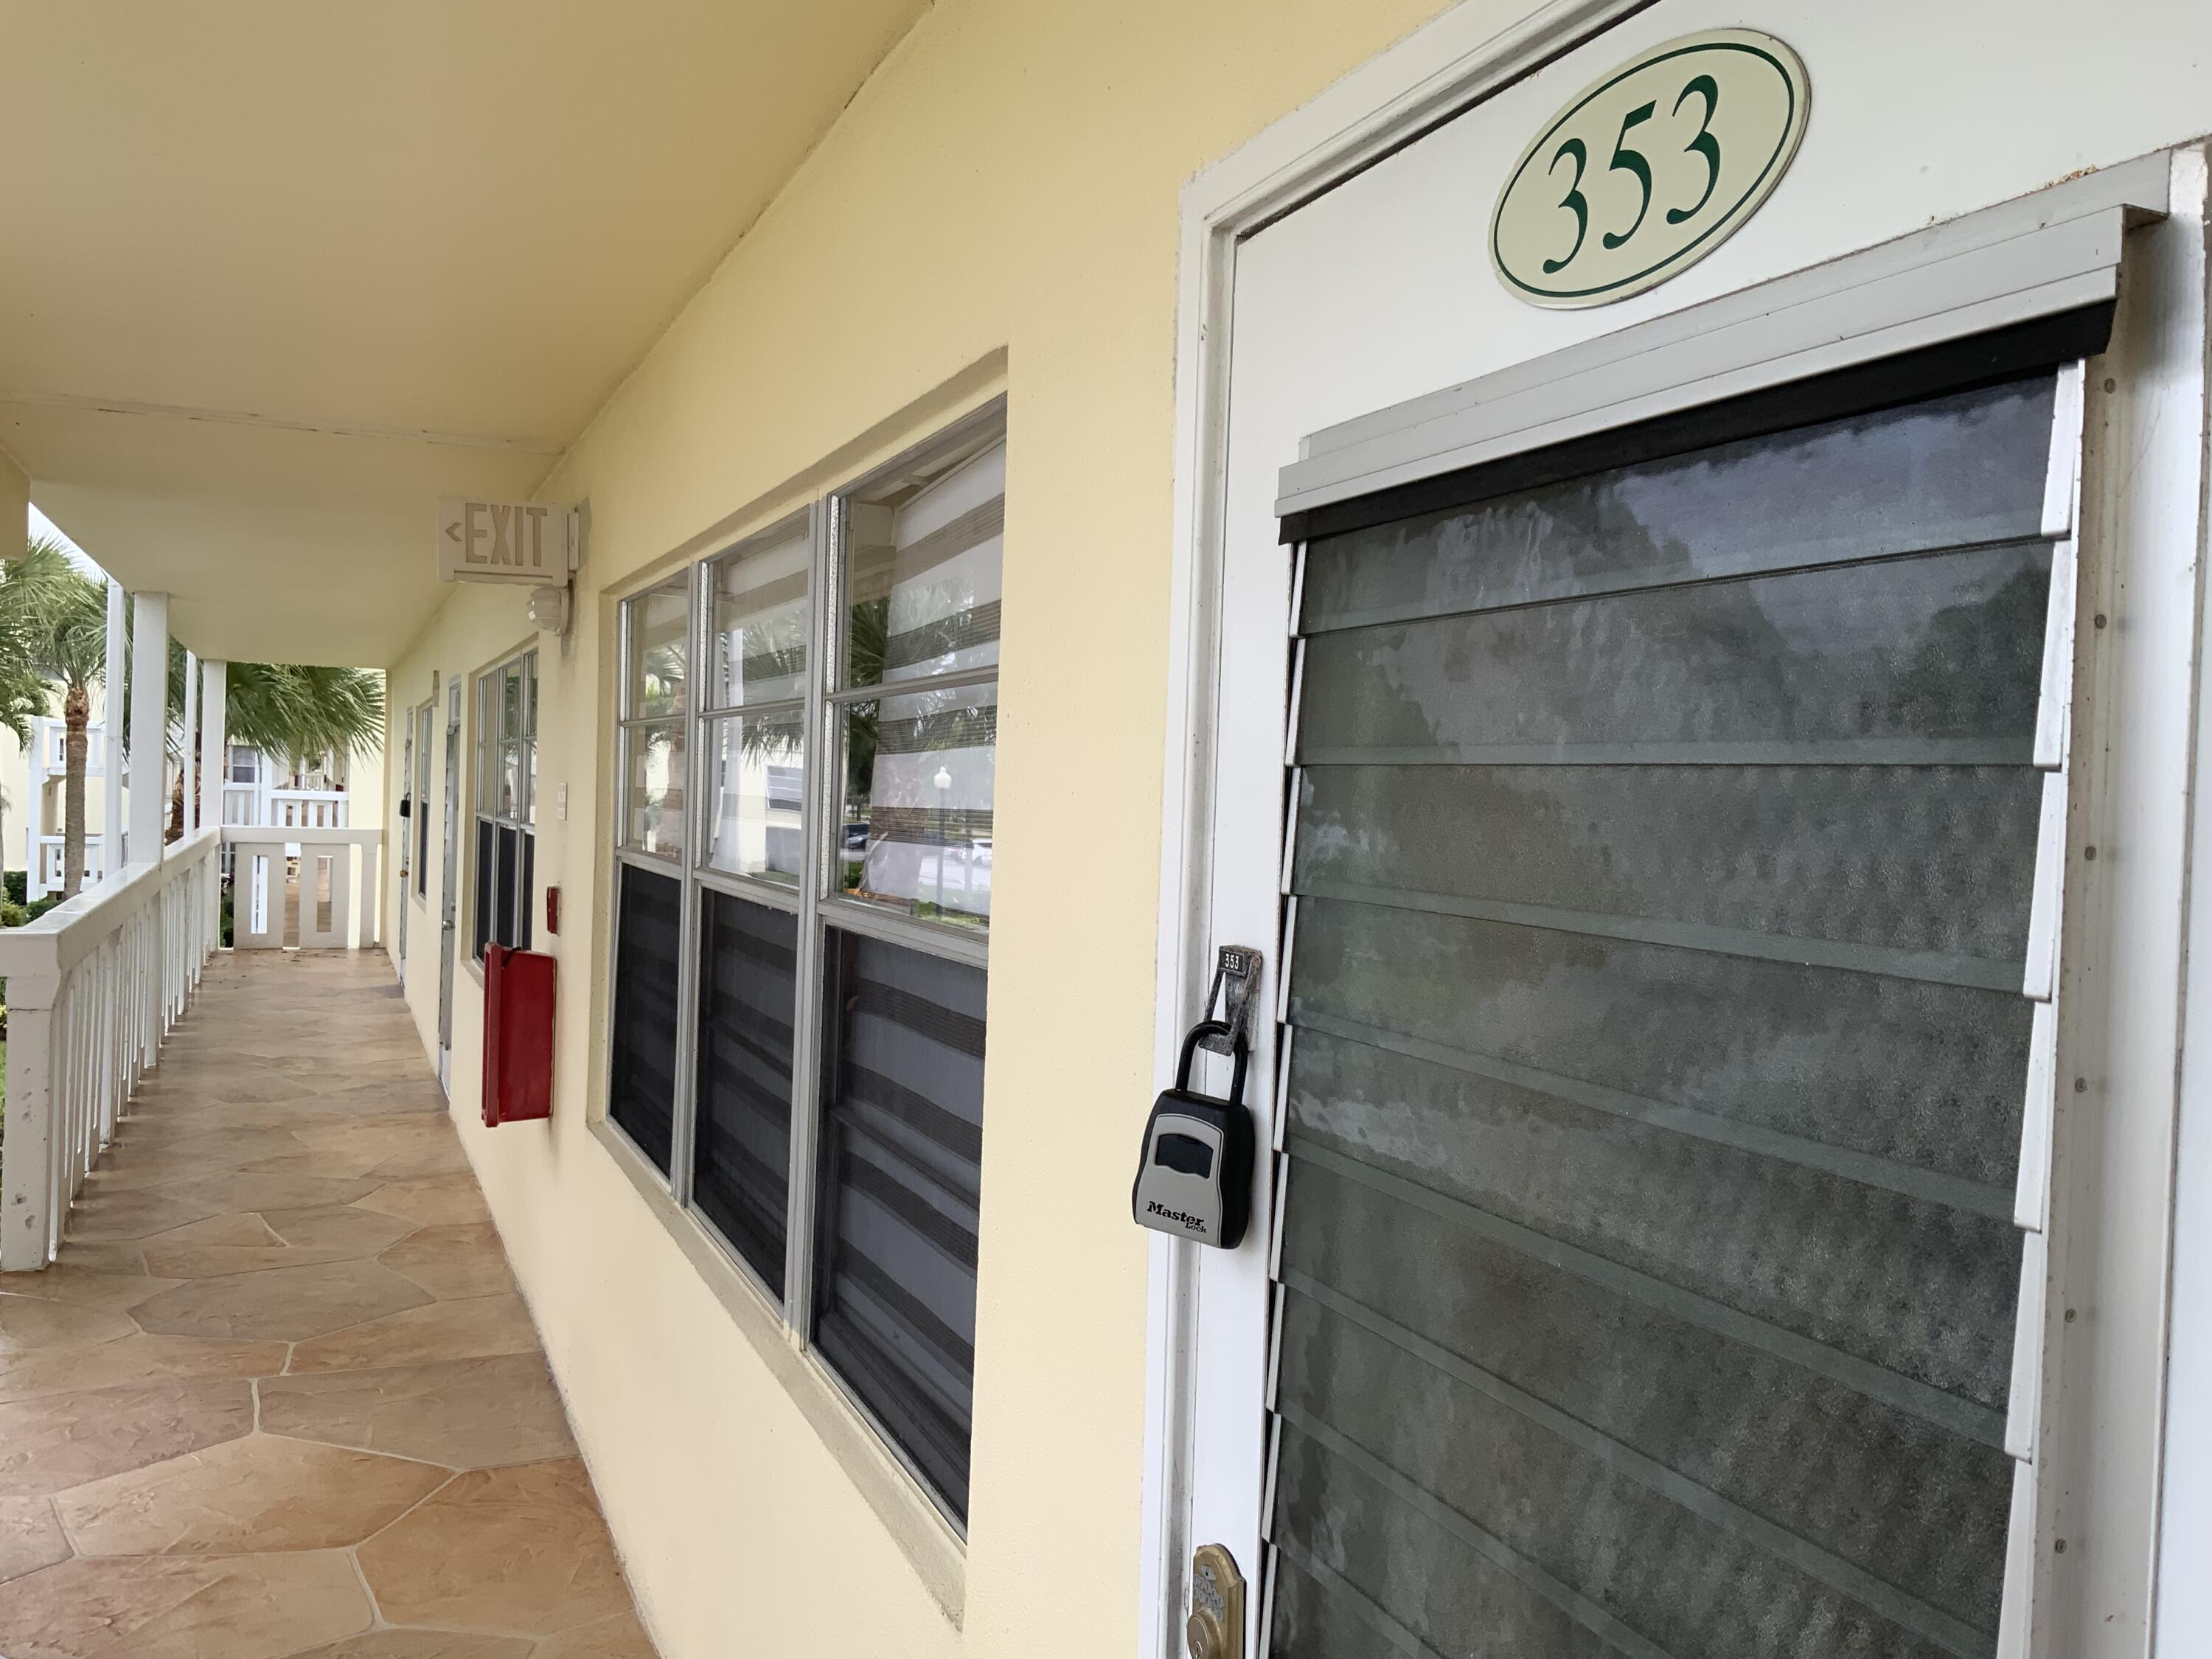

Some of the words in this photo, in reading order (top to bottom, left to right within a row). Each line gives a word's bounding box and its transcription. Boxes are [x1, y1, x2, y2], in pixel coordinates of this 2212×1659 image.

[1543, 74, 1721, 274] 353
[465, 503, 548, 567] EXIT
[1225, 953, 1239, 970] 353
[1147, 1200, 1204, 1226] Master
[1186, 1222, 1207, 1234] Lock
